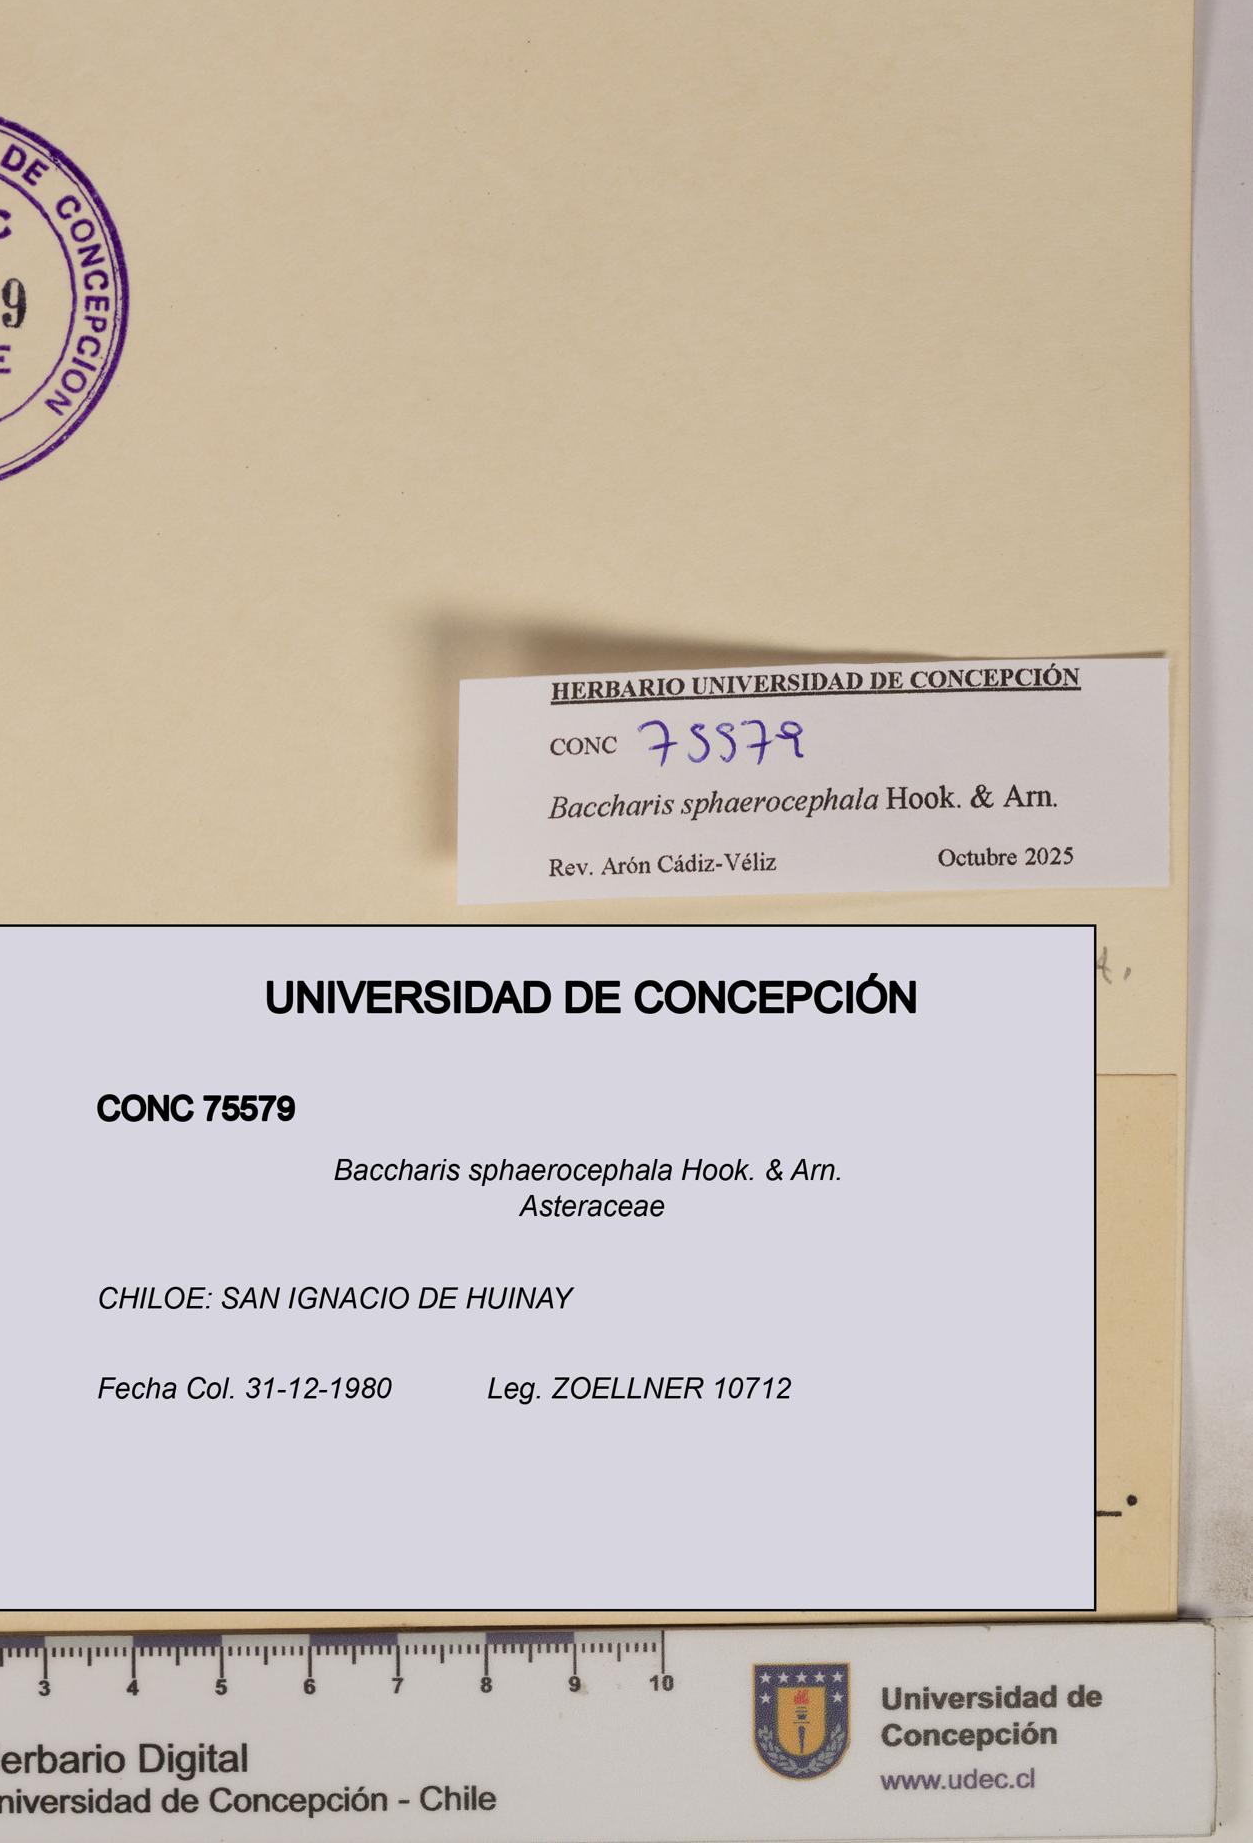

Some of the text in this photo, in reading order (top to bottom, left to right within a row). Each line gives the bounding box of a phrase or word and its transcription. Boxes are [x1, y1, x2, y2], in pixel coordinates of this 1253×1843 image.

[1, 143, 50, 186] DE
[43, 194, 109, 417] CONCEPCION
[551, 663, 1081, 701] HERBARIO UNIVERSIDAD DE CONCEPCIÓN
[550, 720, 803, 766] CONC 75579
[548, 784, 1057, 821] Baccharis sphaerocephala Hook. & Arn.
[549, 852, 776, 876] Rev. Arón Cádiz-Véliz
[938, 847, 1073, 867] Octubre 2025
[37, 1679, 52, 1699] 3
[125, 1679, 141, 1699] 4
[213, 1679, 228, 1698] 5
[302, 1677, 317, 1696] 6
[391, 1679, 405, 1695] 7
[478, 1676, 494, 1694] 8
[567, 1674, 582, 1693] 9
[649, 1673, 675, 1693] 10
[882, 1685, 1102, 1710] Universidad de
[881, 1722, 1057, 1751] Concepción
[139, 1743, 247, 1781] Digital
[880, 1768, 1035, 1790] www.udec.cl
[161, 1788, 199, 1813] de
[209, 1786, 387, 1818] Concepción
[420, 1785, 496, 1811] Chile
